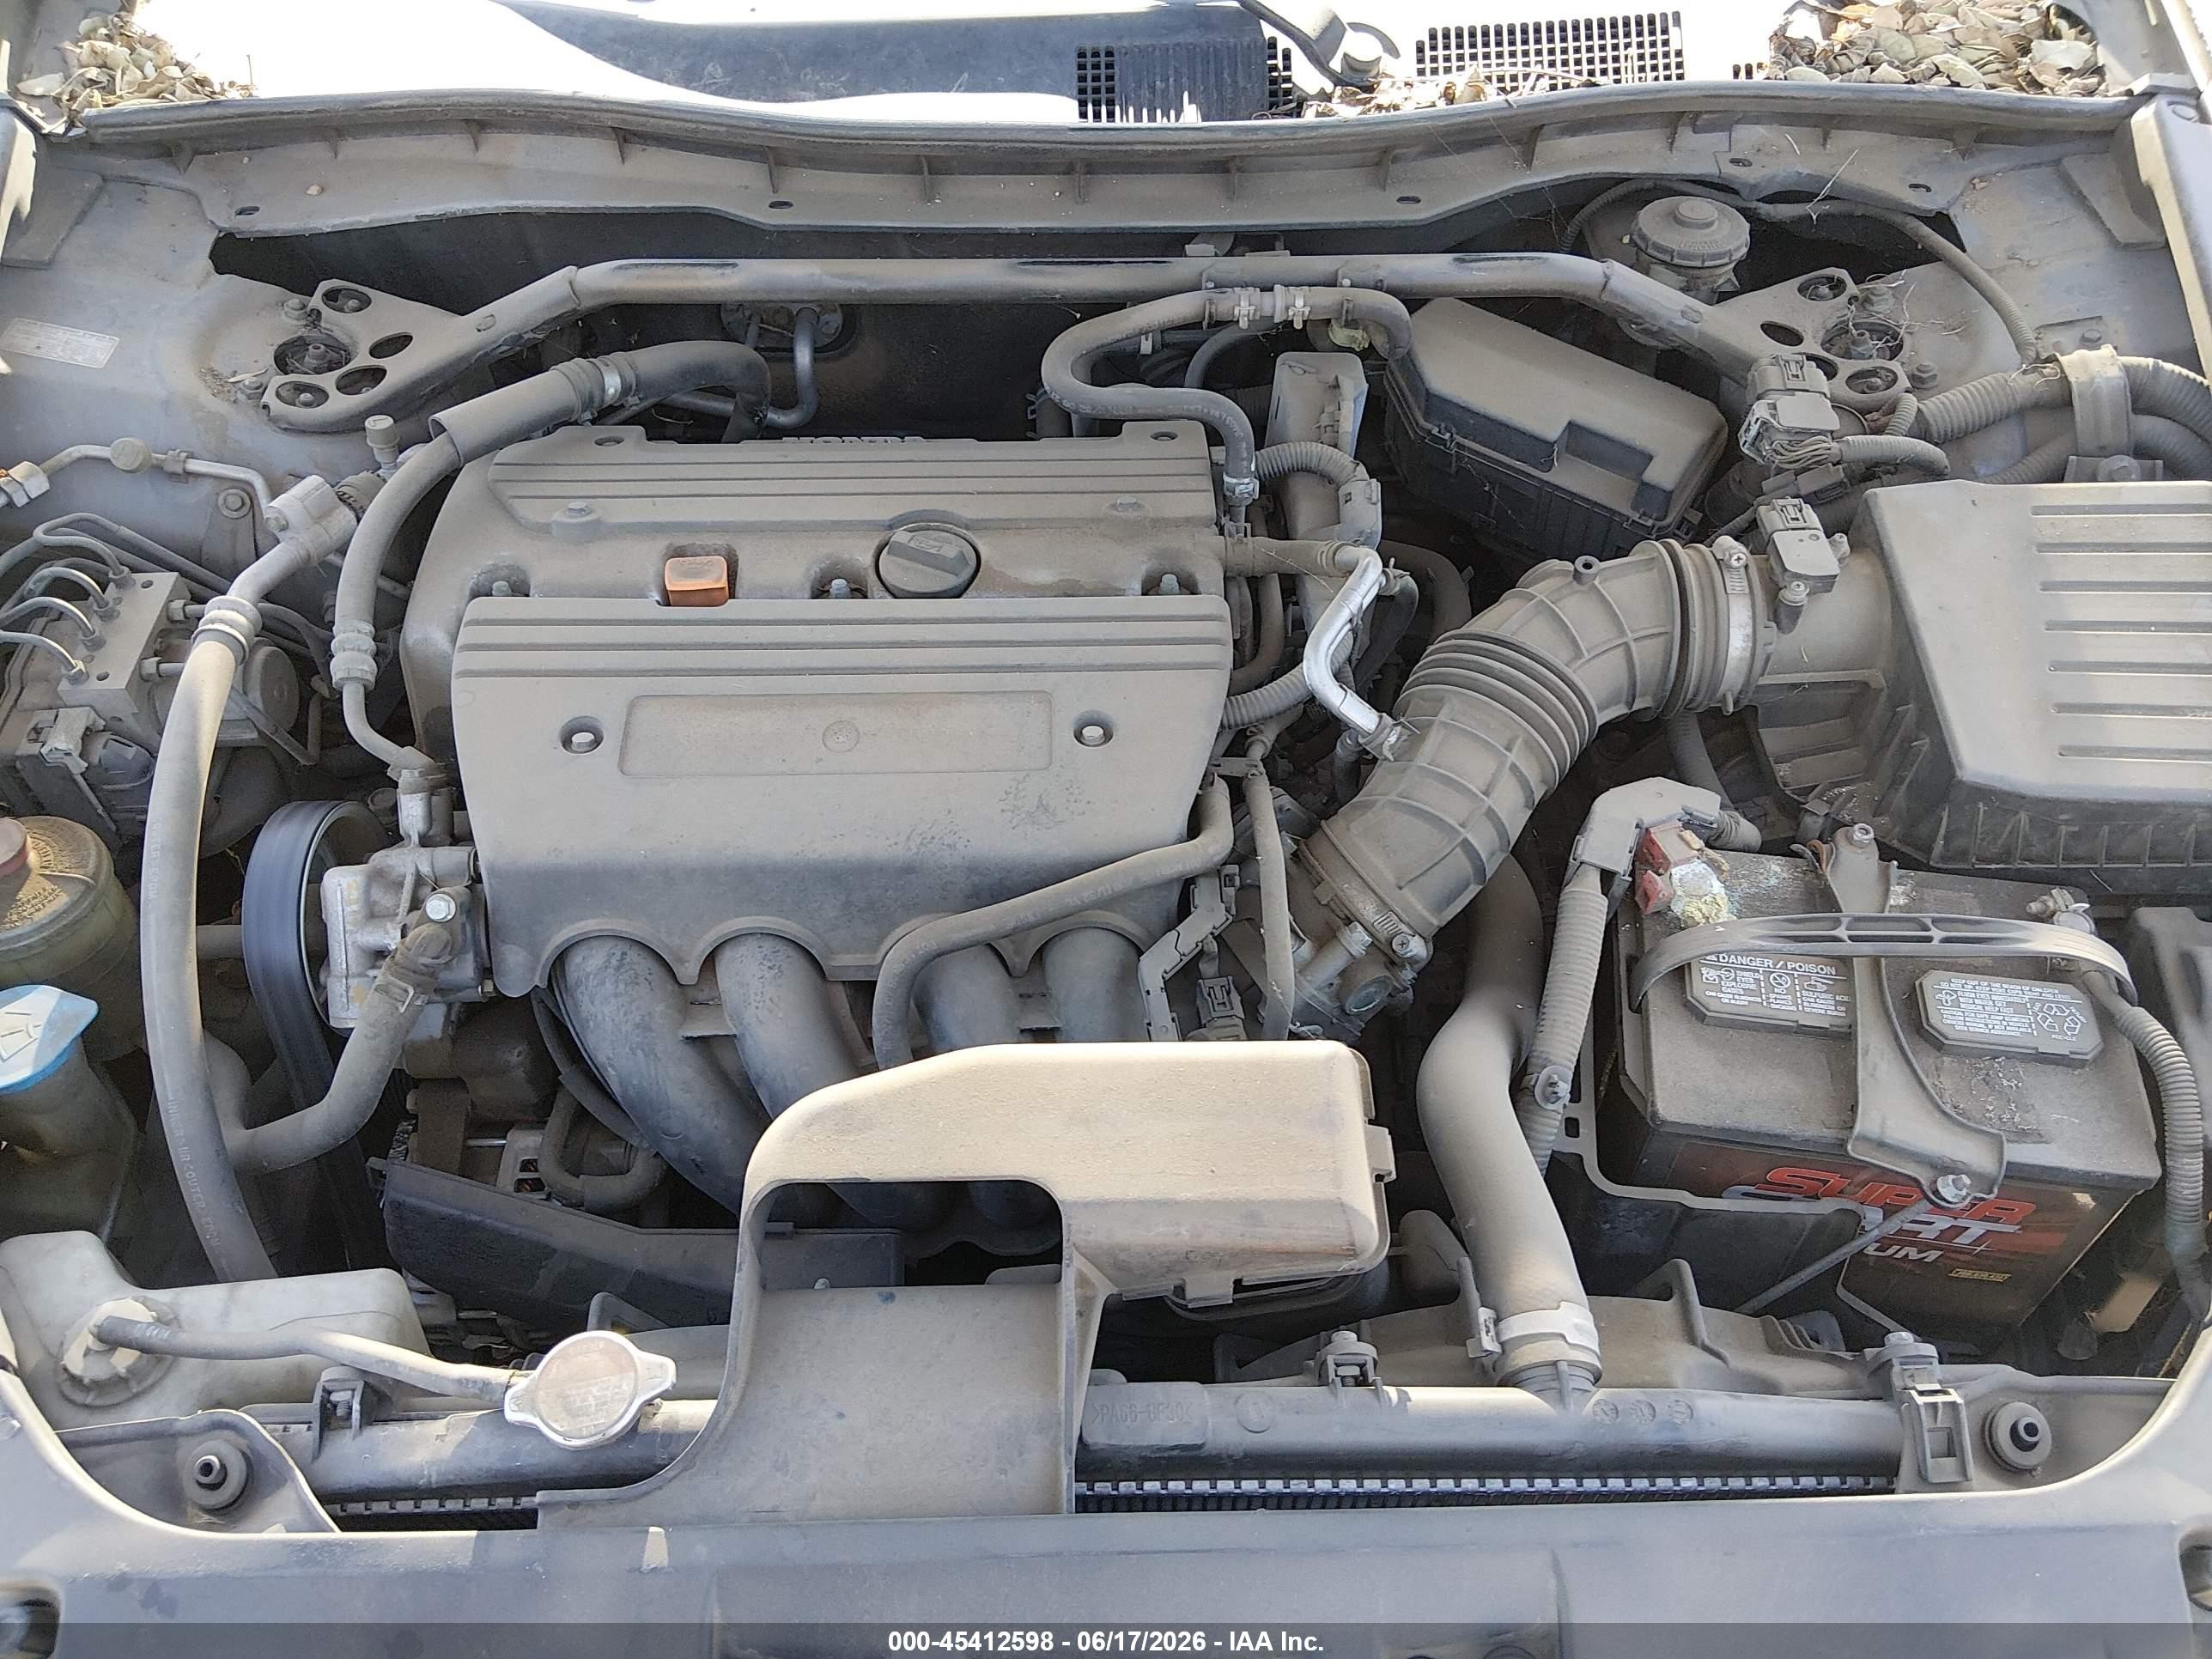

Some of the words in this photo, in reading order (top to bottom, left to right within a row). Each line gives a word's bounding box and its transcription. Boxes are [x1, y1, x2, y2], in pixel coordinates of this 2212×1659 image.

[1719, 954, 1773, 968] DANGER
[1776, 960, 1784, 969] /
[1787, 961, 1836, 975] POISON
[1802, 991, 1833, 1000] SULFURIC
[1754, 1167, 2037, 1225] SUPR
